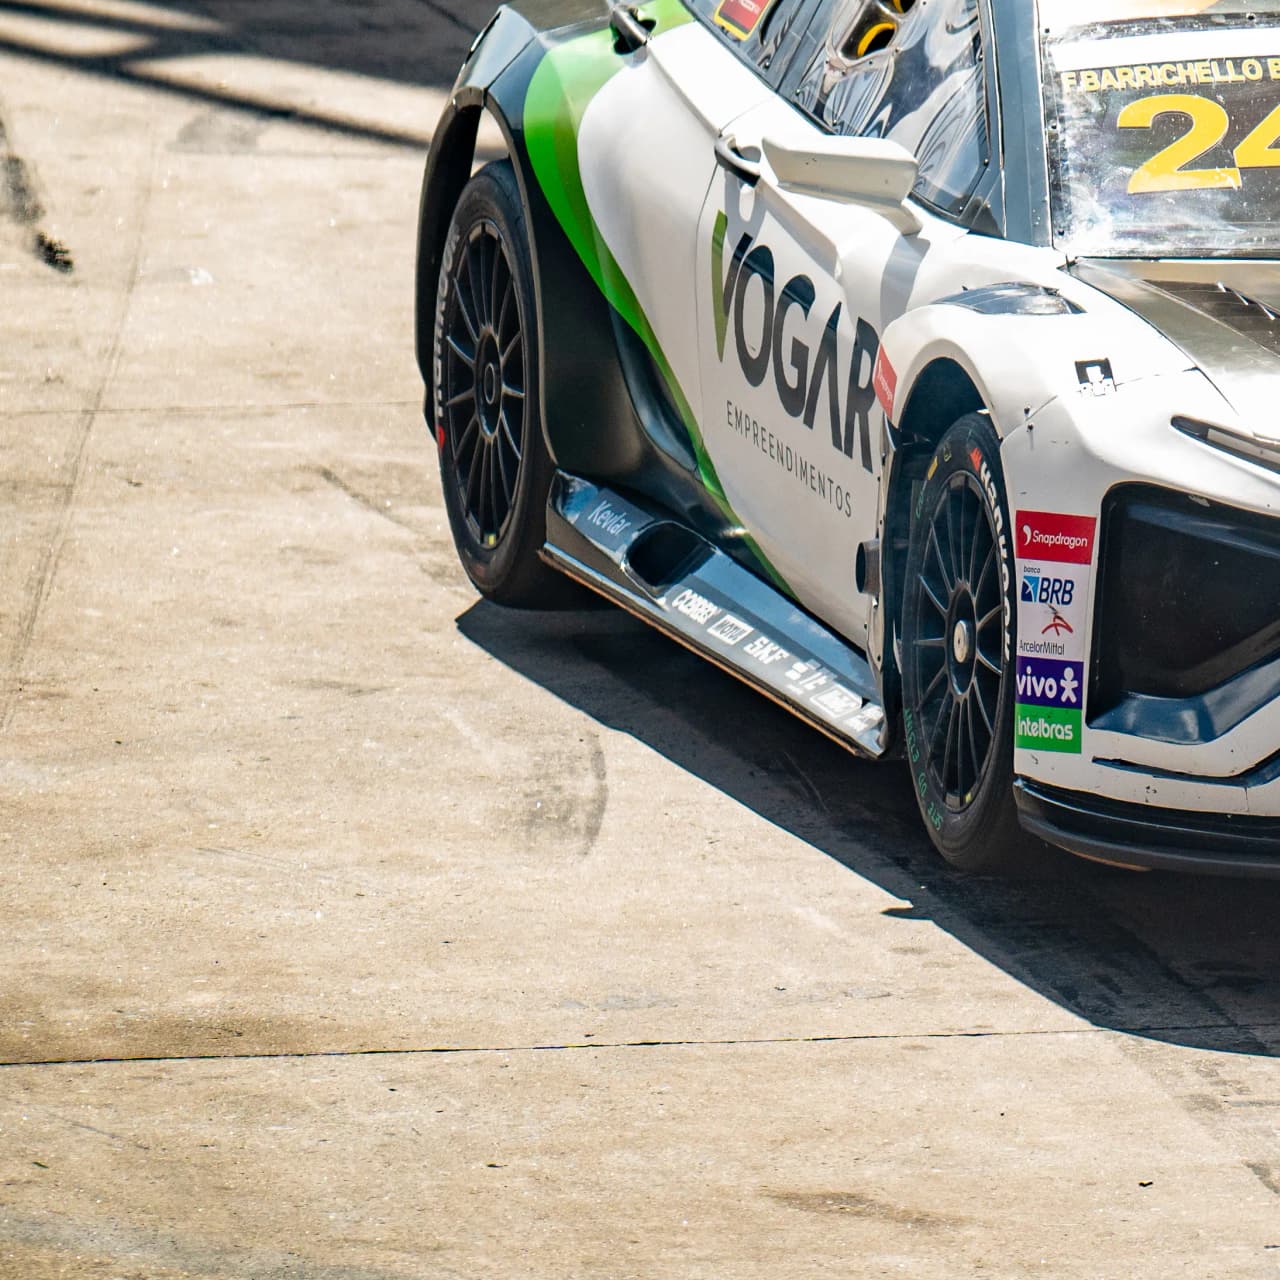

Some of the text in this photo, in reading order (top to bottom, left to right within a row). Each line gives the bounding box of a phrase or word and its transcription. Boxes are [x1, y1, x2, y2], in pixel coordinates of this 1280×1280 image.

[711, 209, 881, 473] VOGAR
[726, 400, 852, 519] EMPREENDIMENTOS
[1032, 530, 1088, 549] Snapdragon
[1038, 577, 1075, 607] BRB
[743, 635, 789, 665] SKF
[1019, 639, 1065, 656] ArcelorMittal
[1016, 665, 1057, 699] vivo
[1017, 715, 1073, 740] intelbras
